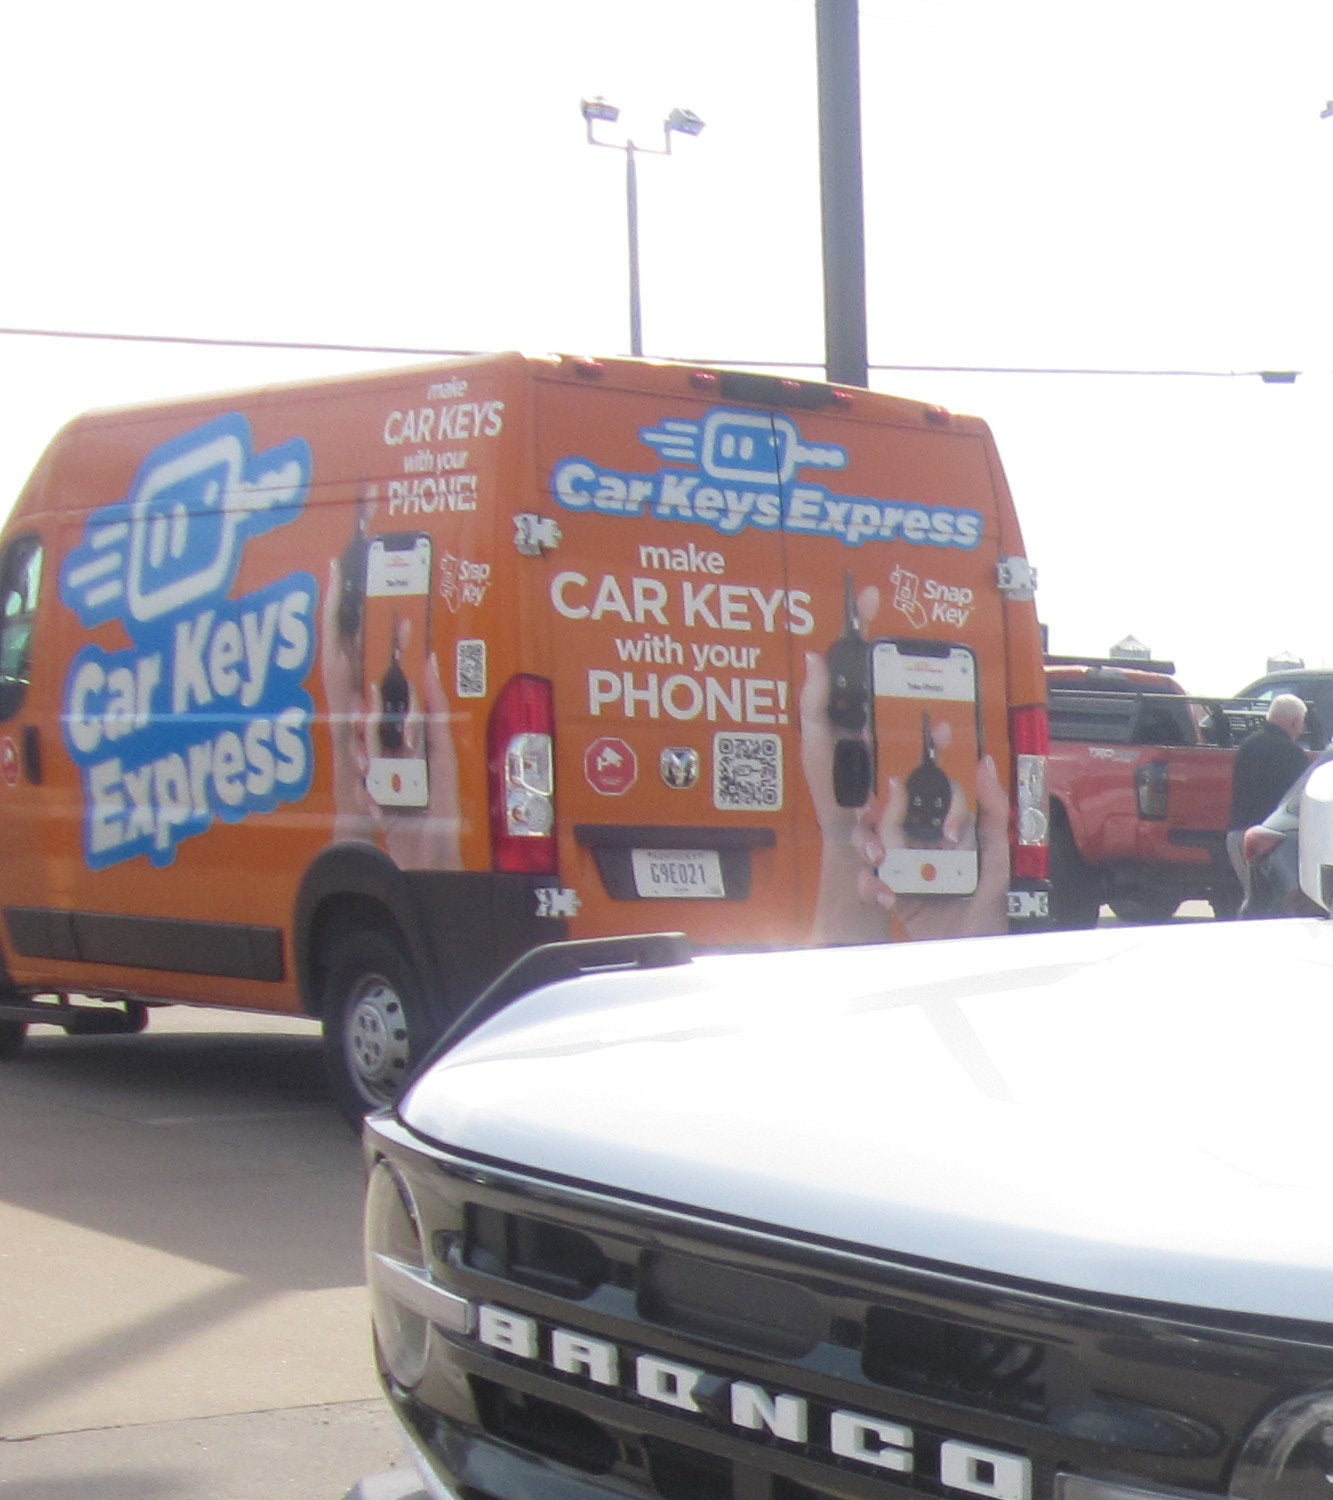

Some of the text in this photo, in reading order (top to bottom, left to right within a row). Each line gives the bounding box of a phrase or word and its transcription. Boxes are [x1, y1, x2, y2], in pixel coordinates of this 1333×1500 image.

[384, 401, 505, 446] CAR KEYS
[388, 475, 477, 516] PHONE!
[555, 463, 980, 544] Car Keys Express
[639, 543, 726, 575] make
[551, 571, 815, 636] CAR KEYS
[923, 579, 973, 607] Snap
[931, 602, 970, 628] Key
[69, 591, 311, 752] Car Keys
[615, 633, 761, 672] with your
[588, 669, 789, 725] PHONE!
[90, 707, 306, 853] Express
[650, 862, 706, 885] G9E021
